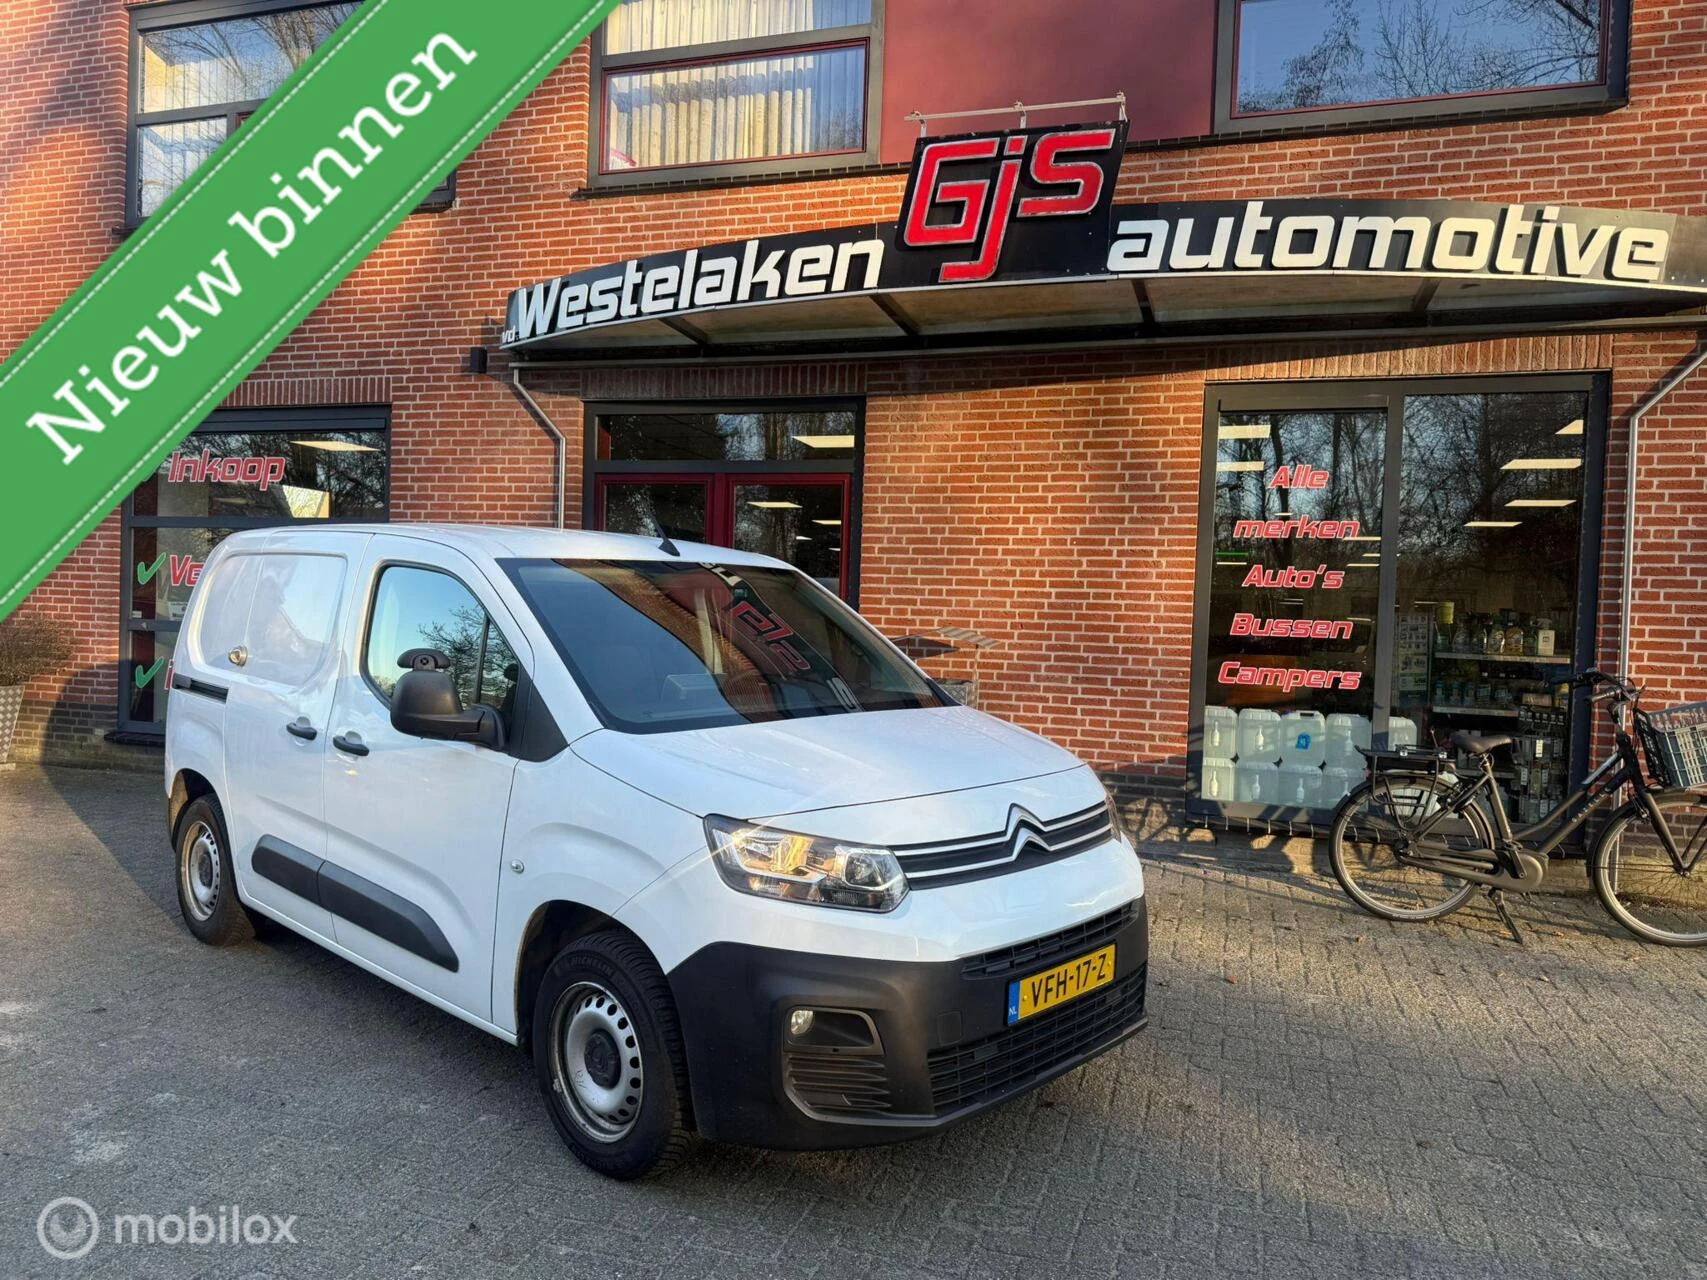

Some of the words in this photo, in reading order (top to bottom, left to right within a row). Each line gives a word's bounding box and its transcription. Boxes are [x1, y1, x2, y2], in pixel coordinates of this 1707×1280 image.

[516, 238, 886, 339] Westelaken
[1107, 201, 1670, 281] automotive
[168, 448, 286, 491] Inkoop
[1268, 464, 1329, 489] Alle
[1233, 515, 1360, 539] merken
[1241, 564, 1345, 589] Auto's
[1230, 613, 1353, 639] Bussen
[1218, 661, 1362, 692] Campers
[1031, 953, 1107, 1008] VFH-17-Z
